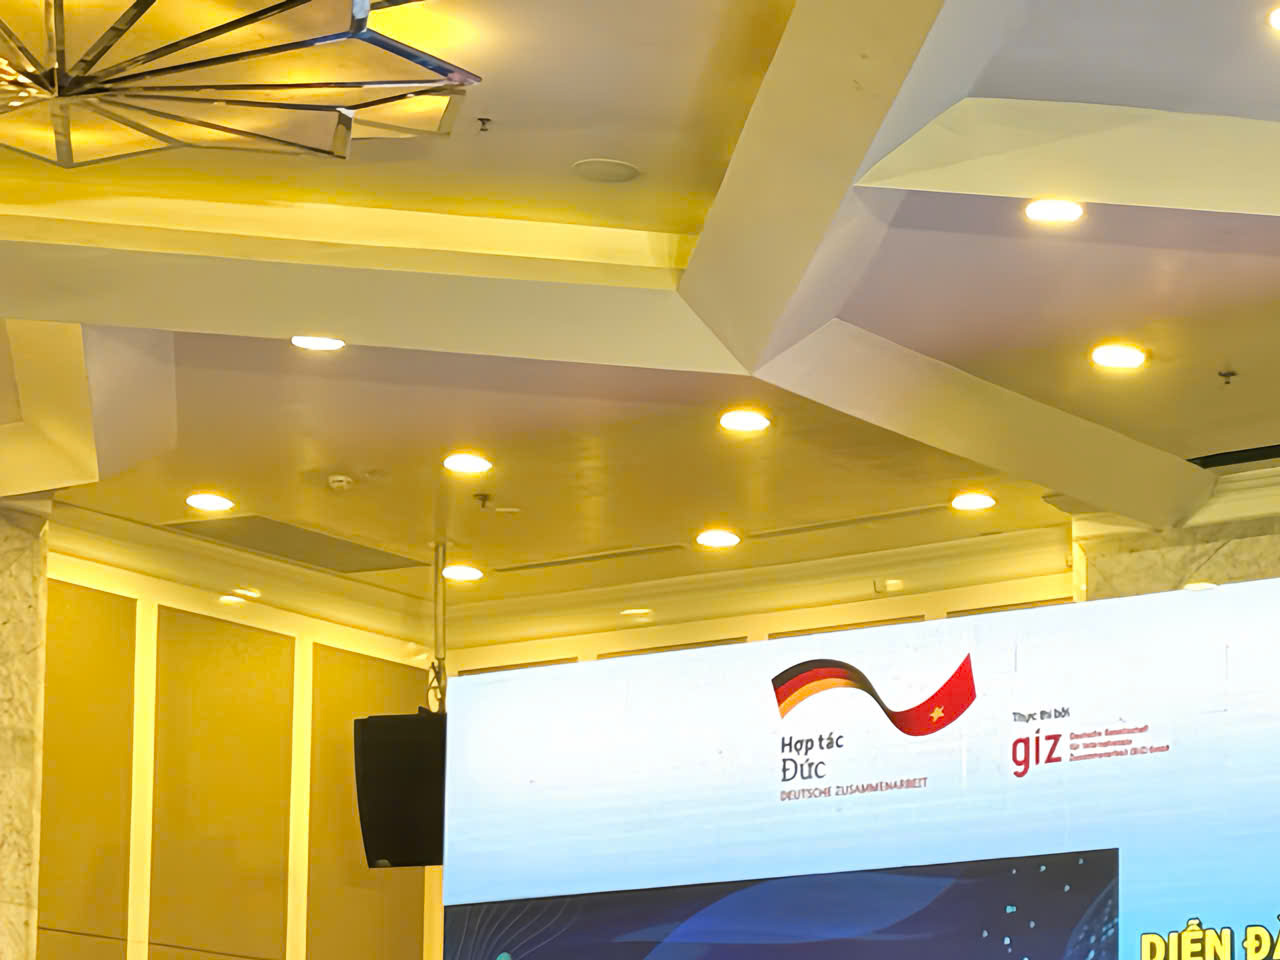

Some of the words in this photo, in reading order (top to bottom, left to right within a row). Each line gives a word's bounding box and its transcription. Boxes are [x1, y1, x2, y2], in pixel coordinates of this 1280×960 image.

[781, 736, 814, 756] Hợp
[818, 732, 844, 750] tác
[781, 758, 826, 782] Đức
[780, 786, 832, 801] DEUTSCHE
